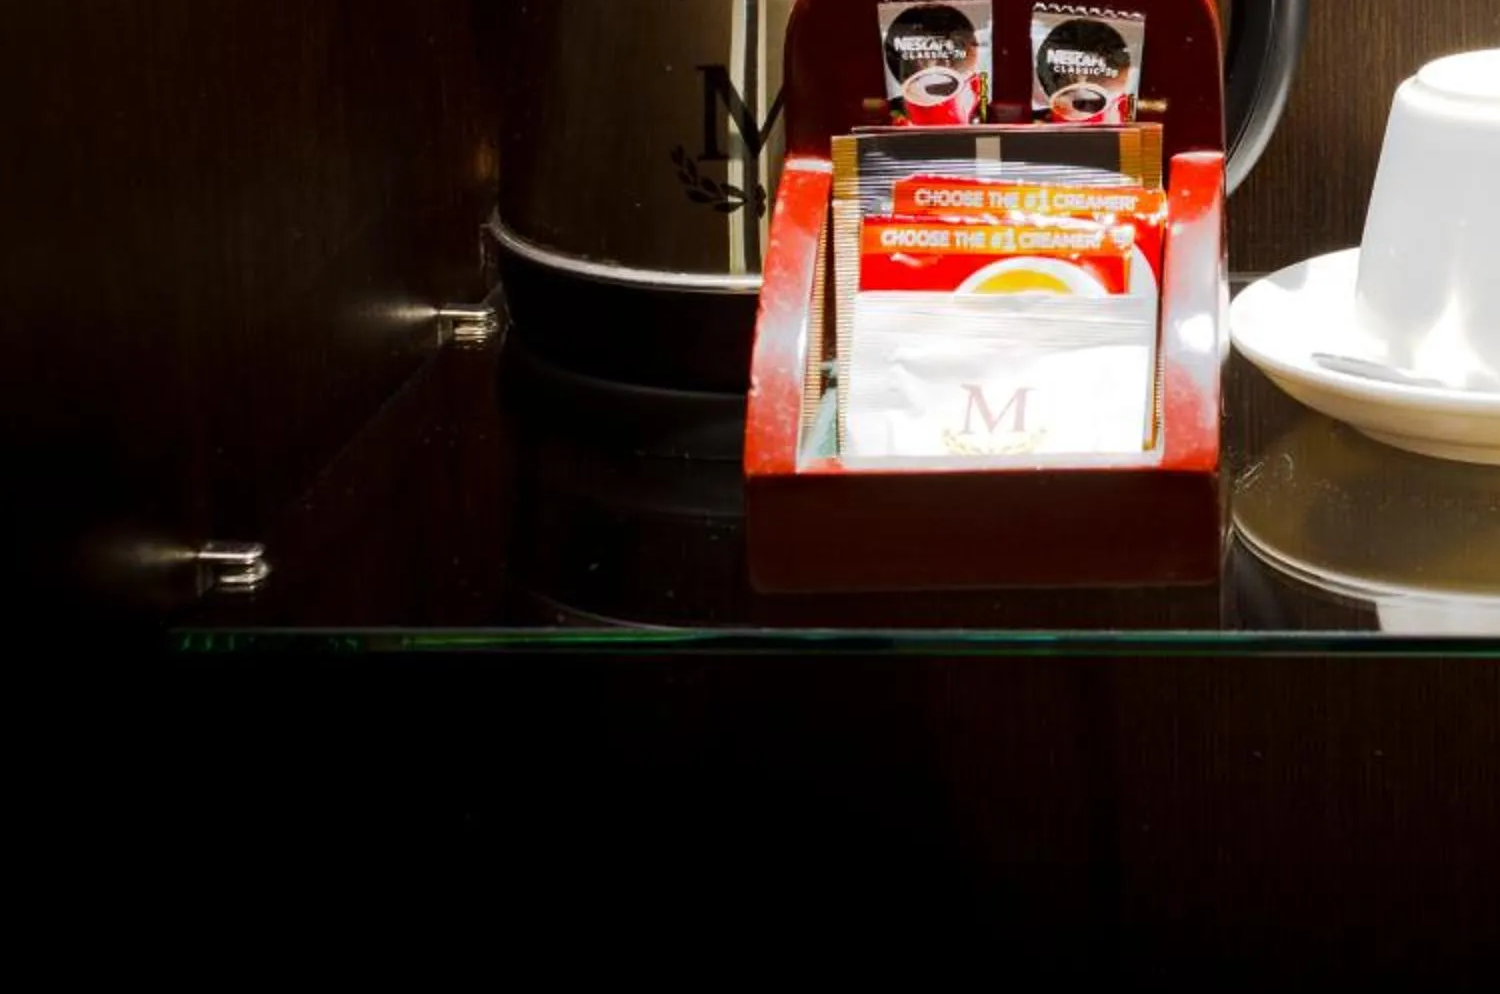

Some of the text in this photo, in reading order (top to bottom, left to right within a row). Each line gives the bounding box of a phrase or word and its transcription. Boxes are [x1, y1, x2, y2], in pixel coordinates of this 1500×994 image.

[914, 188, 985, 207] CHOOSE
[989, 190, 1020, 208] THE
[880, 228, 952, 247] CHOOSE
[954, 229, 986, 248] THE
[958, 383, 1038, 434] M
